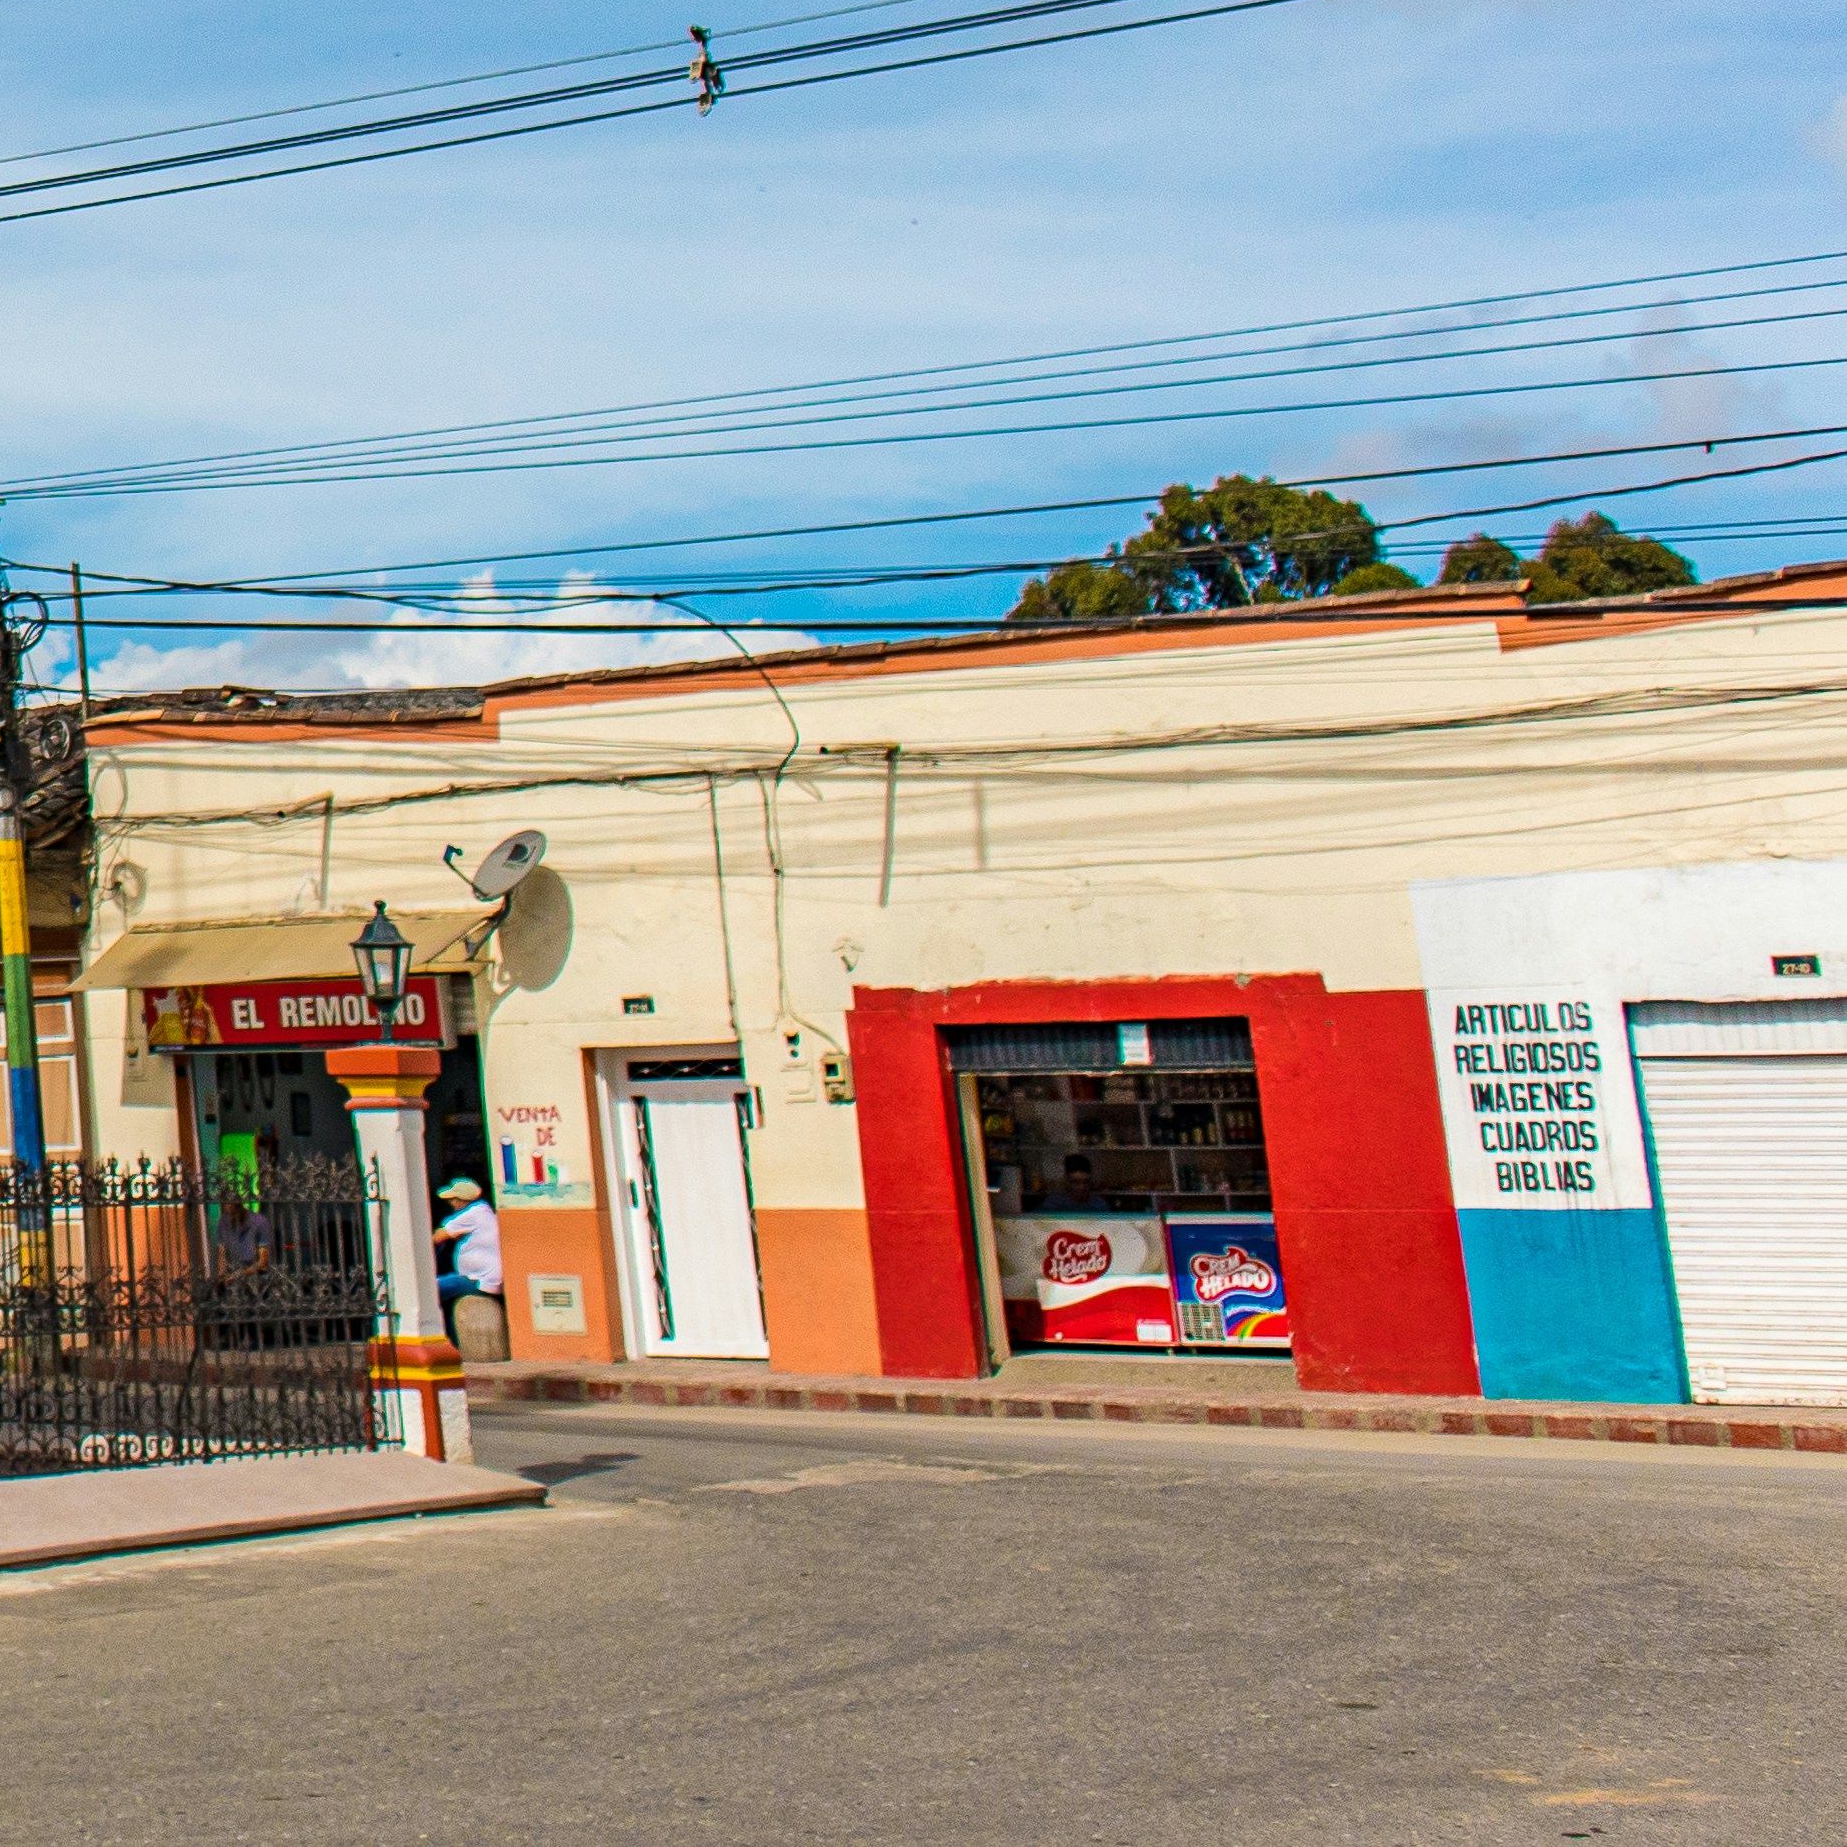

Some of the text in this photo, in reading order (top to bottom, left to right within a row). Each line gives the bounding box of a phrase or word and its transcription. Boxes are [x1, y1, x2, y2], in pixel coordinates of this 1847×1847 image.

[231, 998, 265, 1030] EL
[1455, 1002, 1594, 1034] ARTICULOS
[1454, 1041, 1602, 1074] RELIGIOSOS
[1470, 1081, 1596, 1112] IMAGENES
[497, 1104, 563, 1123] VENTA
[536, 1125, 557, 1146] DE
[1480, 1120, 1599, 1152] CUADROS
[1496, 1161, 1596, 1192] BIBLIAS
